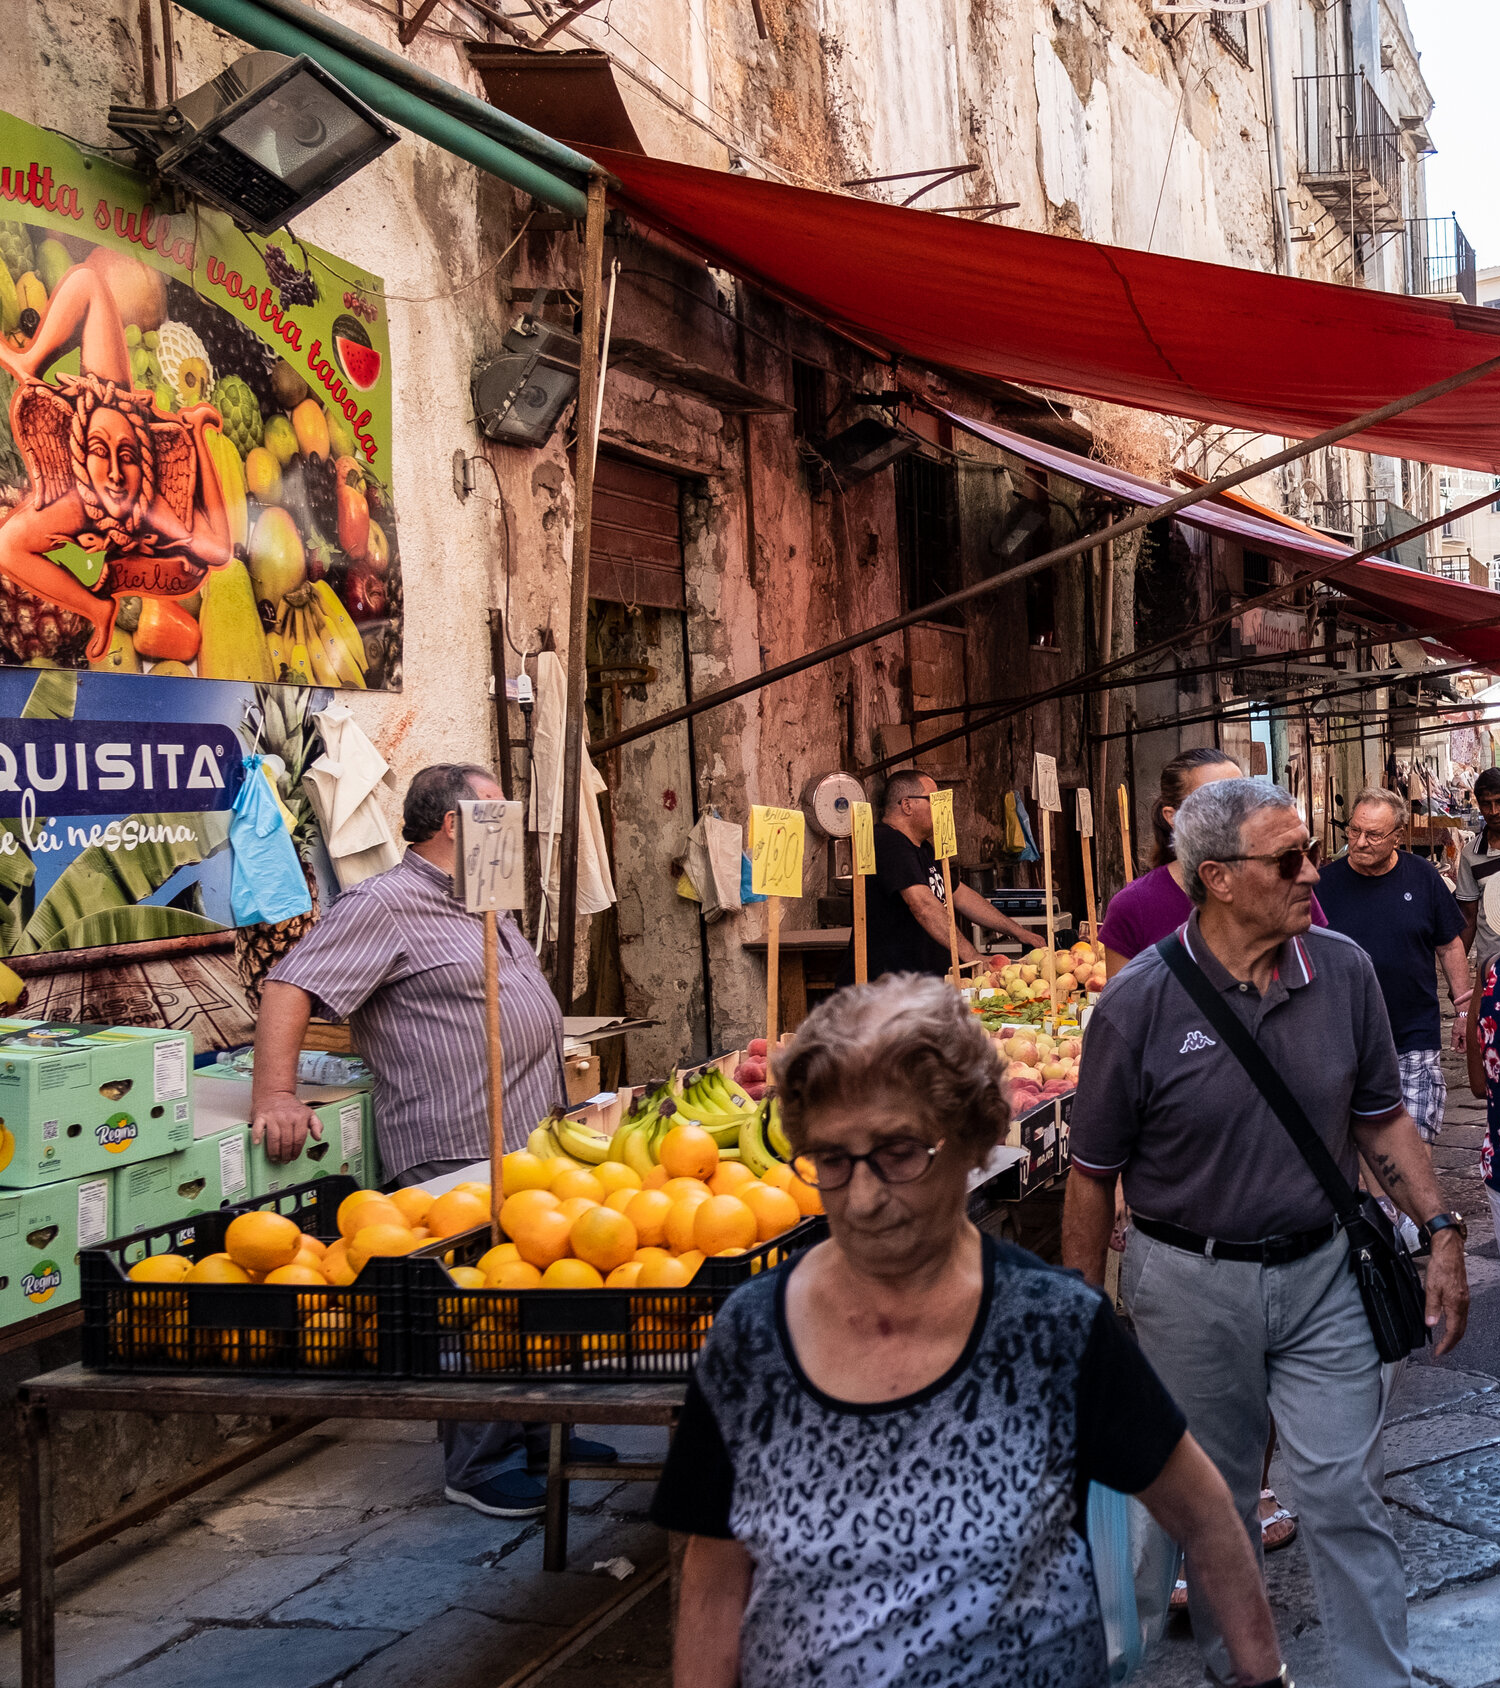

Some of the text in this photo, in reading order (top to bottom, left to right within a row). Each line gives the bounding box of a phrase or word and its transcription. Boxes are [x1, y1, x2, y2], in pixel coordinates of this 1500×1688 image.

[93, 198, 196, 271] sulla
[206, 255, 302, 351] vostra
[307, 338, 379, 464] tavola
[112, 562, 187, 592] Sicilia
[21, 787, 63, 852] lei
[67, 820, 199, 851] nessuna.
[95, 1121, 138, 1146] Regina
[21, 1270, 61, 1297] Regina
